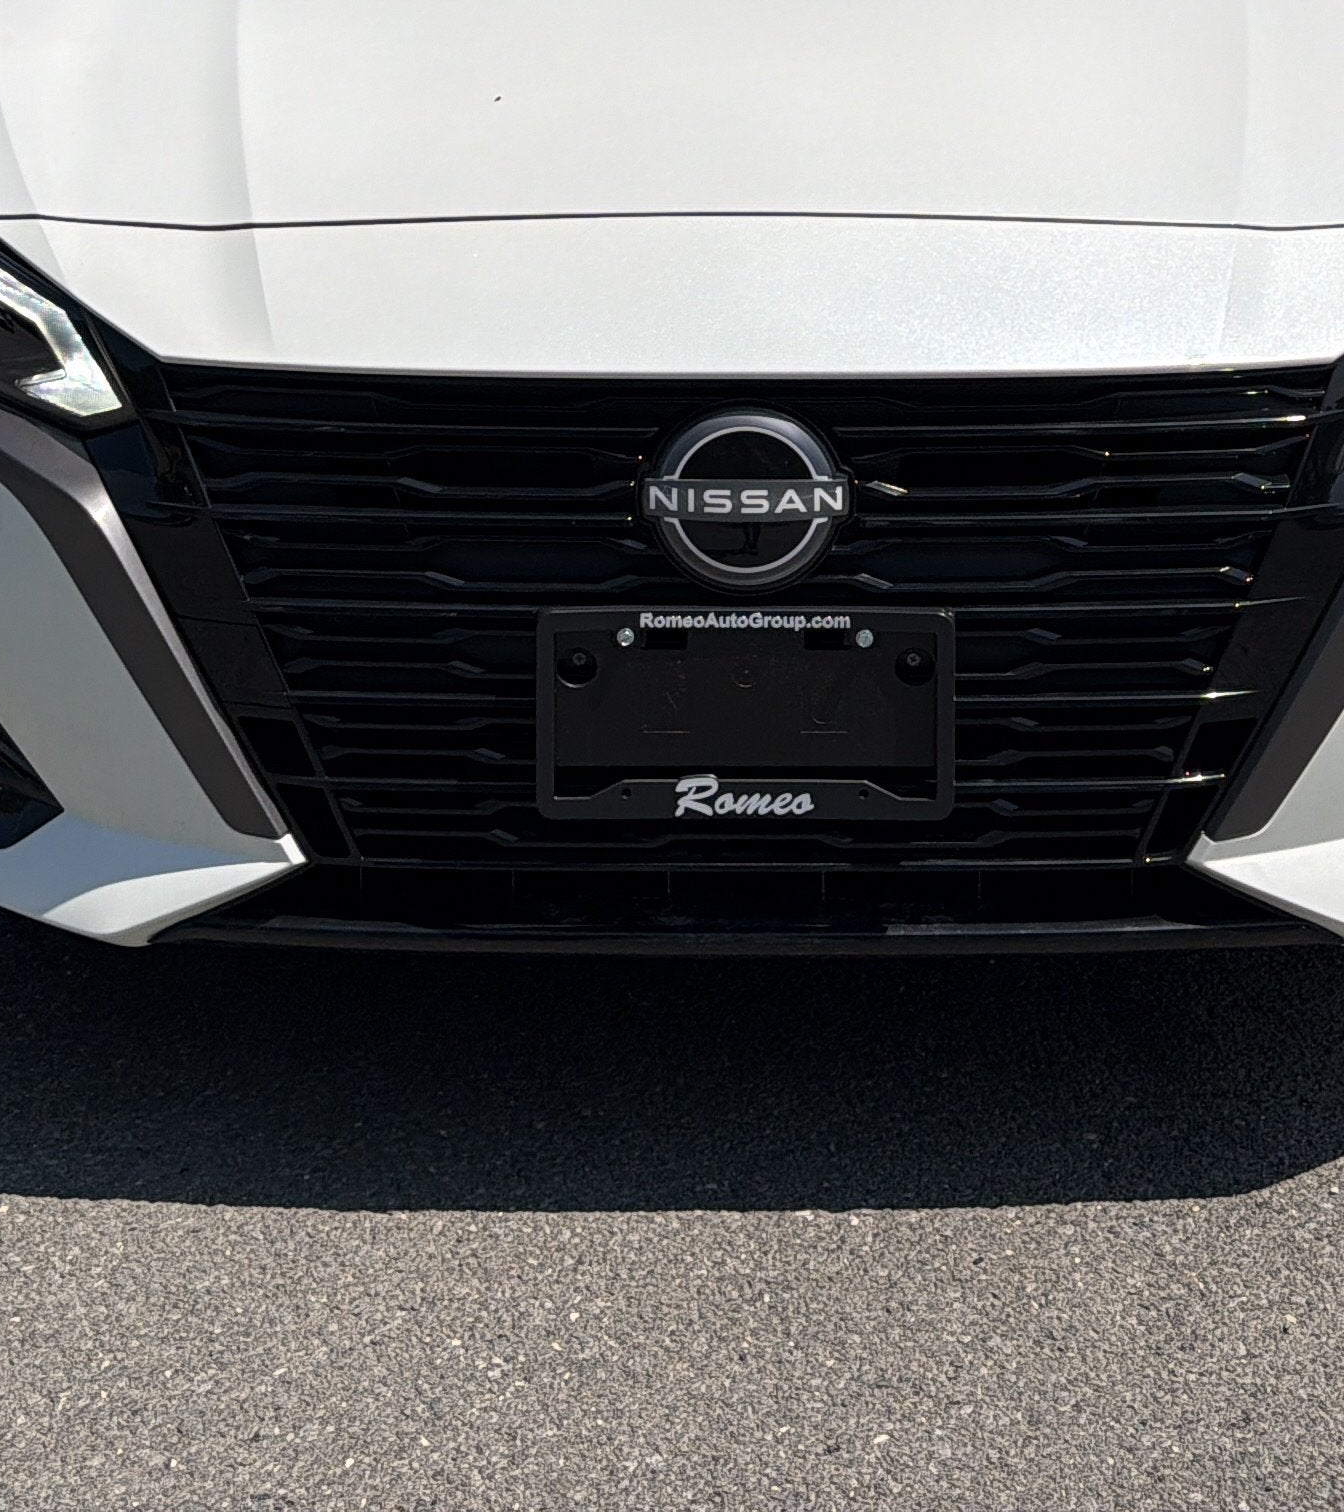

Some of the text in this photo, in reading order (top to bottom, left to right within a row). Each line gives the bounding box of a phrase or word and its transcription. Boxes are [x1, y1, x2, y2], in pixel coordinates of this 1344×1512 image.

[649, 485, 843, 514] NISSAN
[639, 611, 852, 632] RomeoAutoGroup.com
[674, 774, 815, 817] Romeo
